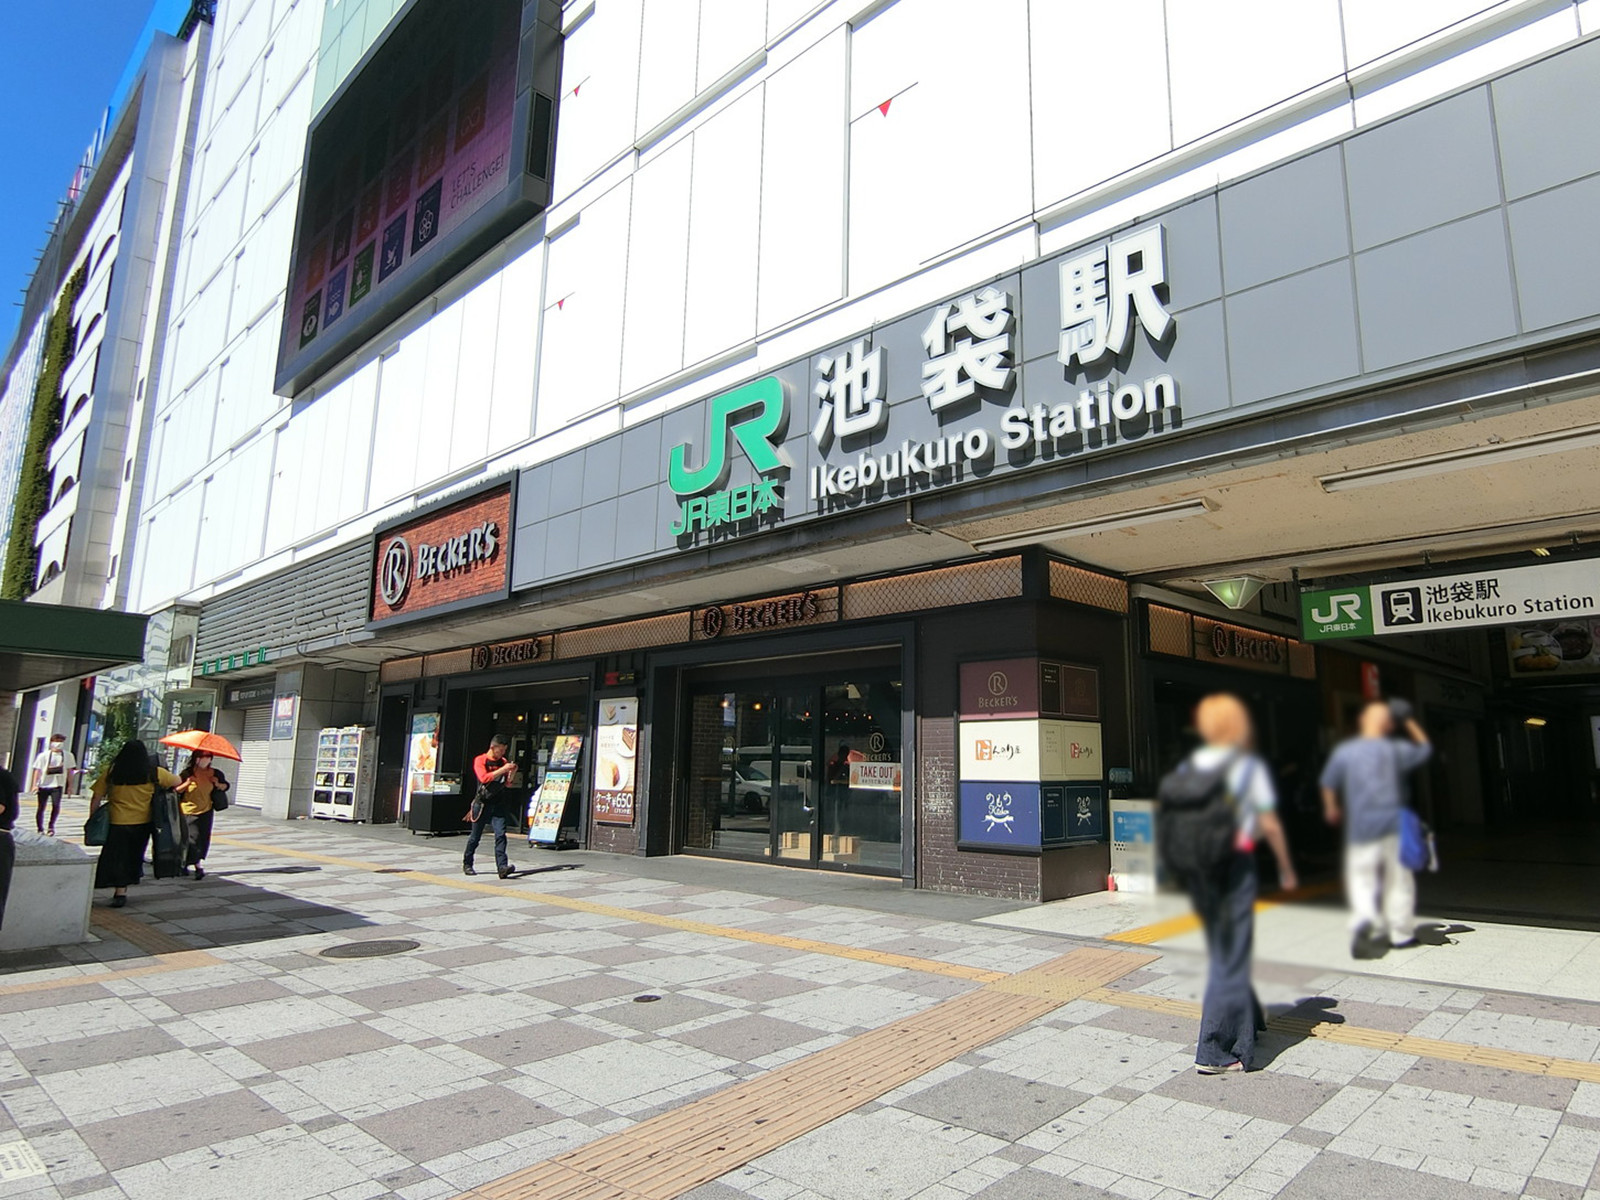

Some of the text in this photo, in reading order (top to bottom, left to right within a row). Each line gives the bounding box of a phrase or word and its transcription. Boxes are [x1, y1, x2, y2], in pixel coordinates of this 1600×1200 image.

[451, 154, 504, 209] CHALLENGE!
[453, 162, 476, 192] LET'S
[811, 223, 1175, 450] 池袋駅
[669, 376, 790, 494] JR
[810, 372, 1178, 500] Ikebukuro Station
[669, 476, 779, 537] JR東日本
[417, 521, 499, 579] BECKER'S
[1425, 578, 1501, 606] 池袋駅
[732, 591, 817, 630] BECKER'S
[1311, 593, 1362, 623] JR
[1427, 594, 1595, 623] Ikebukuro Station
[1319, 622, 1357, 633] JR東日本
[493, 640, 539, 665] BECKER'S
[978, 696, 1018, 708] BECKER'S
[860, 765, 894, 779] TAKE OUT
[595, 803, 610, 813] セット
[596, 792, 612, 802] ケーキ
